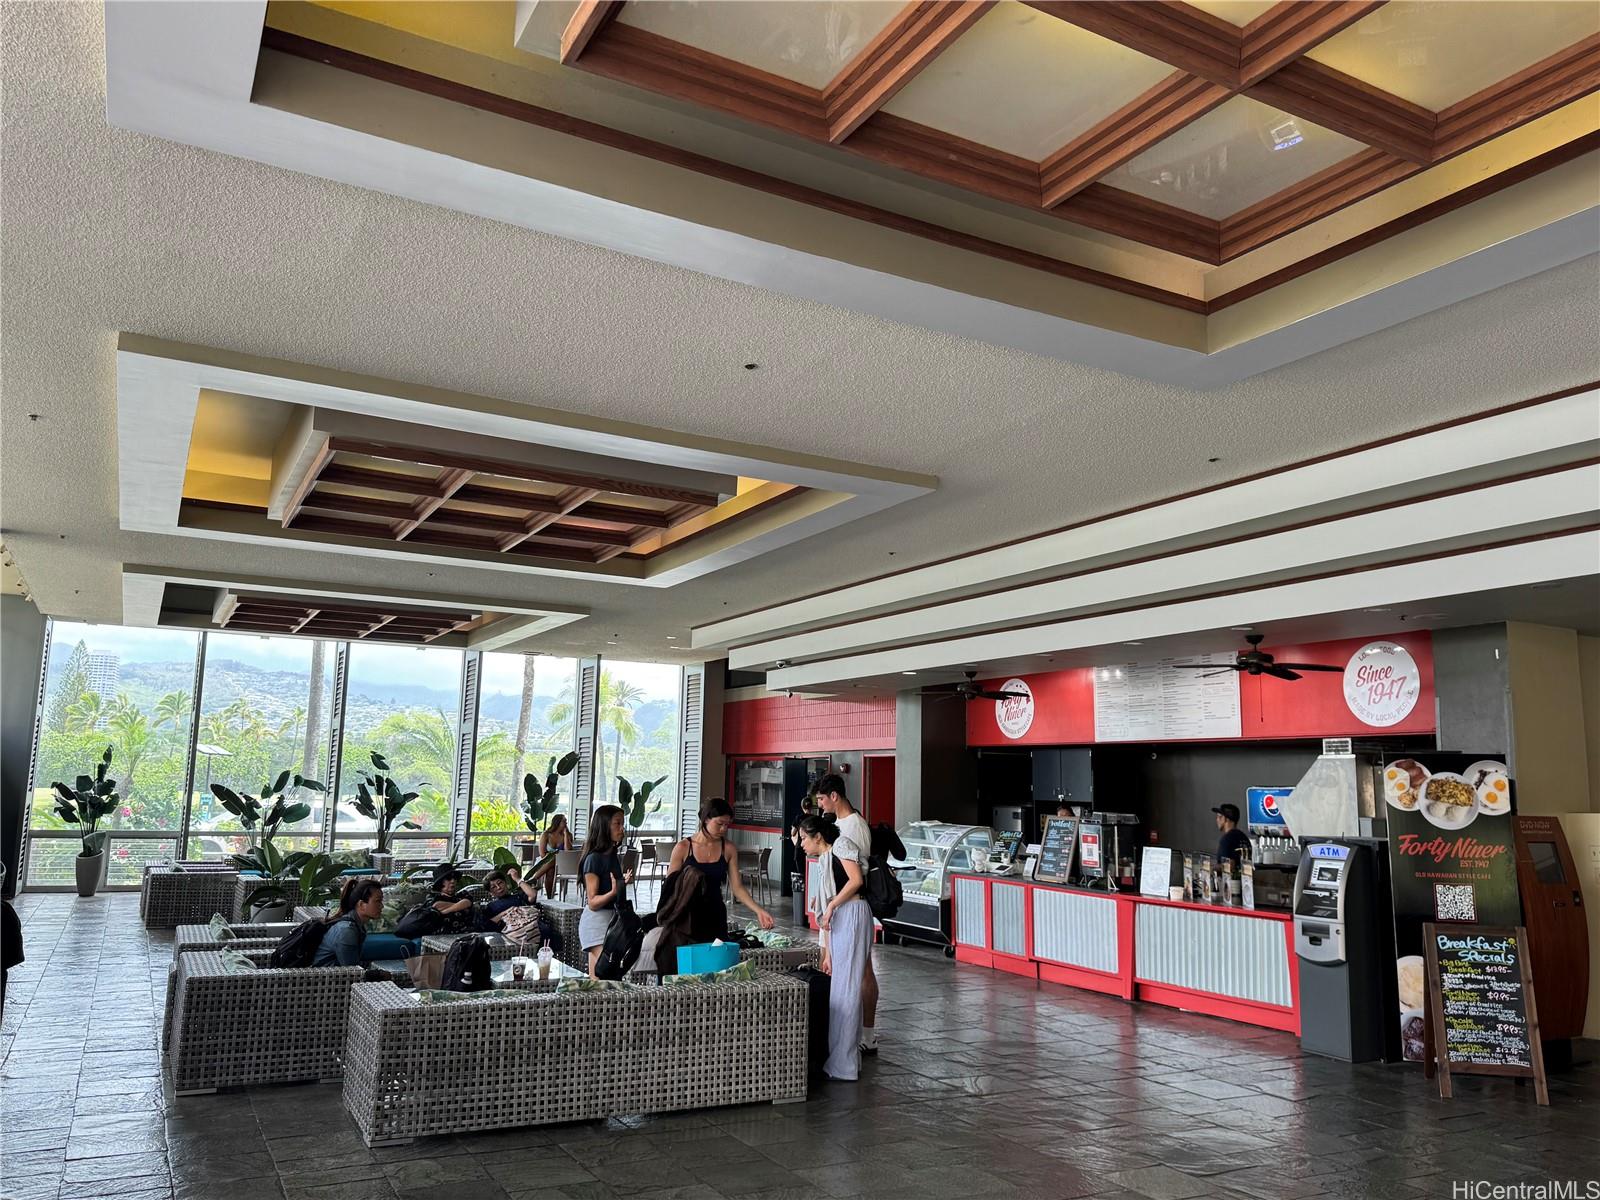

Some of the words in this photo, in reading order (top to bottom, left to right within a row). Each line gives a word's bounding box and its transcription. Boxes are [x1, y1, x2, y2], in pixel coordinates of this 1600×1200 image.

[1356, 665, 1393, 687] Since
[1368, 676, 1407, 706] 1947
[1320, 847, 1340, 857] ATM
[1398, 834, 1453, 863] Forty
[1451, 837, 1506, 858] Niner
[1437, 935, 1509, 951] Breakfast
